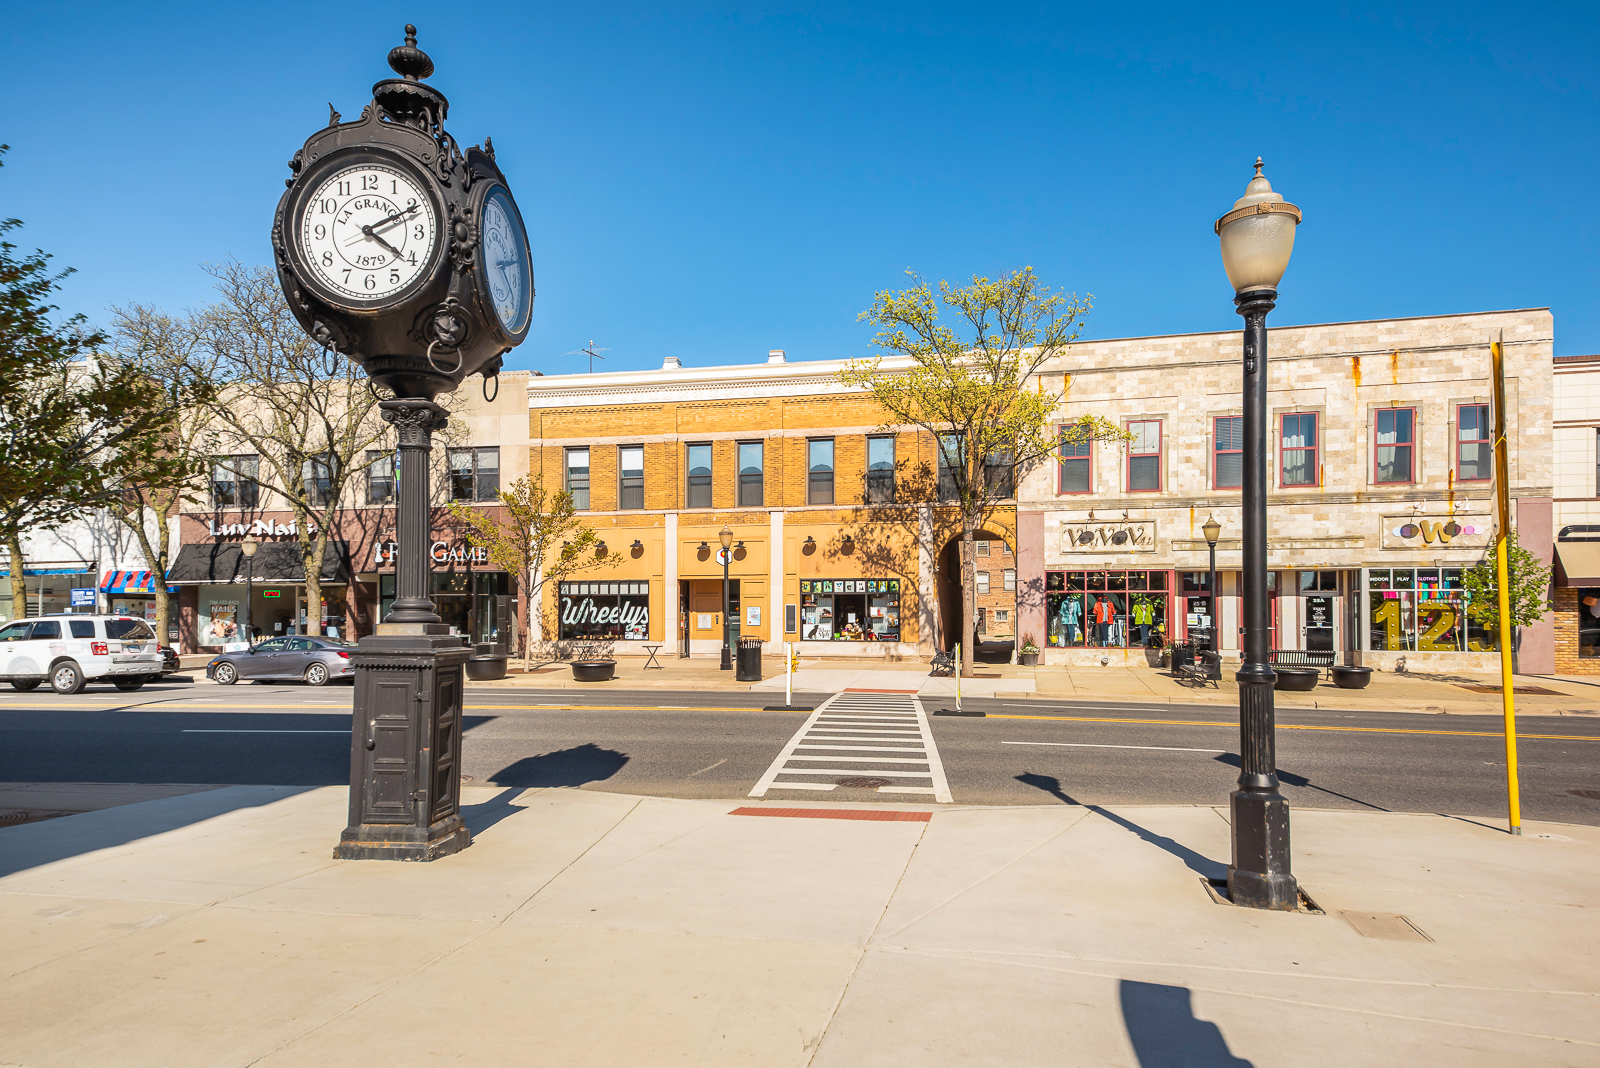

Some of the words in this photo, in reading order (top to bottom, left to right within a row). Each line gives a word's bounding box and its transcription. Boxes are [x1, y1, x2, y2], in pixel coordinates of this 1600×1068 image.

[337, 181, 351, 196] 11
[361, 174, 378, 190] 12
[390, 179, 398, 194] 1
[319, 198, 337, 214] 10
[406, 198, 418, 213] 2
[337, 210, 353, 226] LA
[494, 210, 501, 229] 12
[315, 224, 326, 240] 9
[414, 224, 425, 240] 3
[504, 226, 508, 240] 1
[322, 251, 333, 267] 8
[355, 255, 386, 267] 1879
[406, 250, 418, 266] 4
[342, 269, 352, 284] 7
[365, 274, 376, 290] 6
[390, 268, 399, 284] 5
[512, 273, 517, 288] 3
[493, 283, 504, 298] 1879
[208, 519, 251, 536] Luv
[253, 518, 315, 536] Nais
[562, 597, 649, 631] Wheelys
